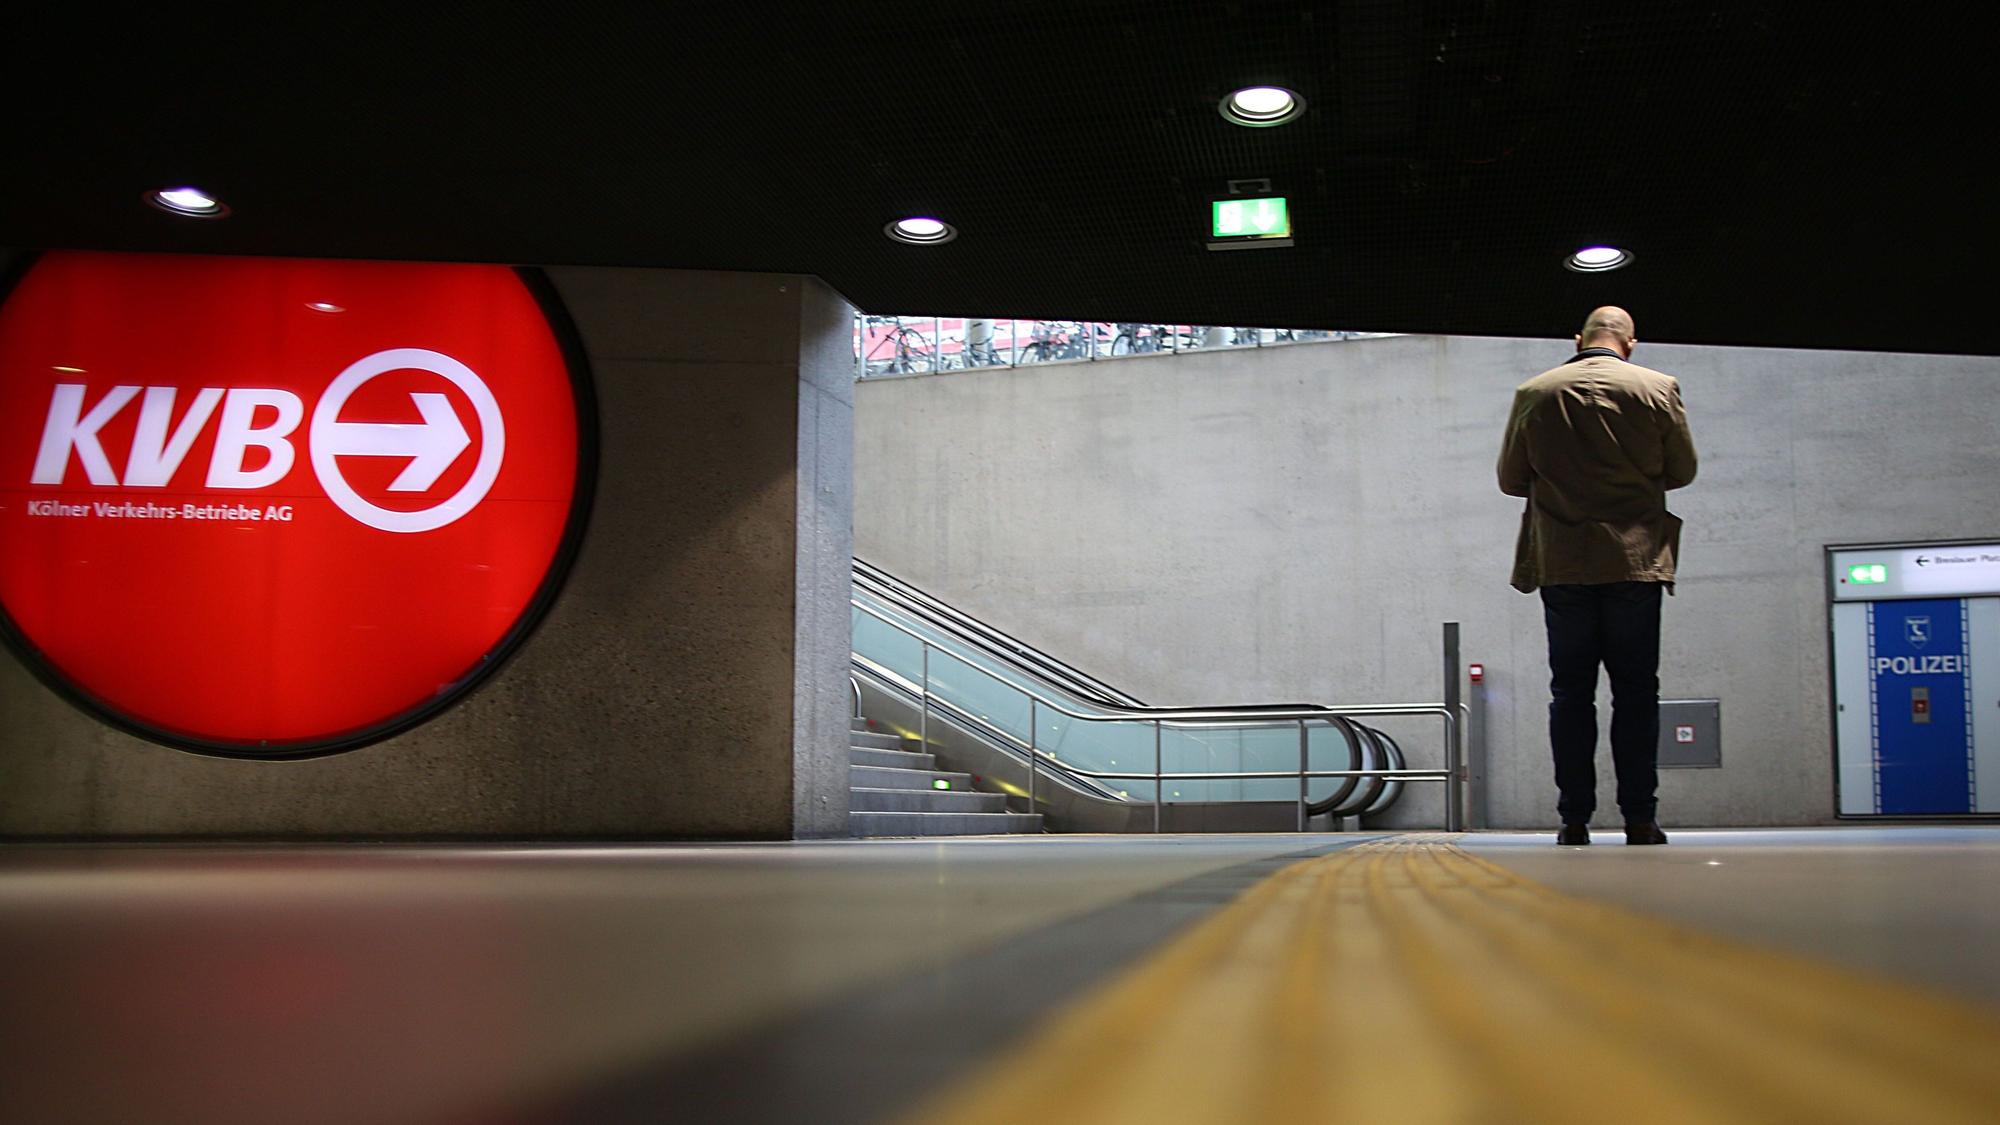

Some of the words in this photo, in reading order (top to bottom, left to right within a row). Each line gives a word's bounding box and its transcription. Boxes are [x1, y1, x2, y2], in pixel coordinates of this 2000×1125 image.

[30, 384, 304, 489] KVB
[28, 500, 90, 517] Kölner
[93, 502, 261, 521] Verkehrs-Betriebe
[264, 506, 293, 521] AG
[1876, 655, 1962, 675] POLIZEI
